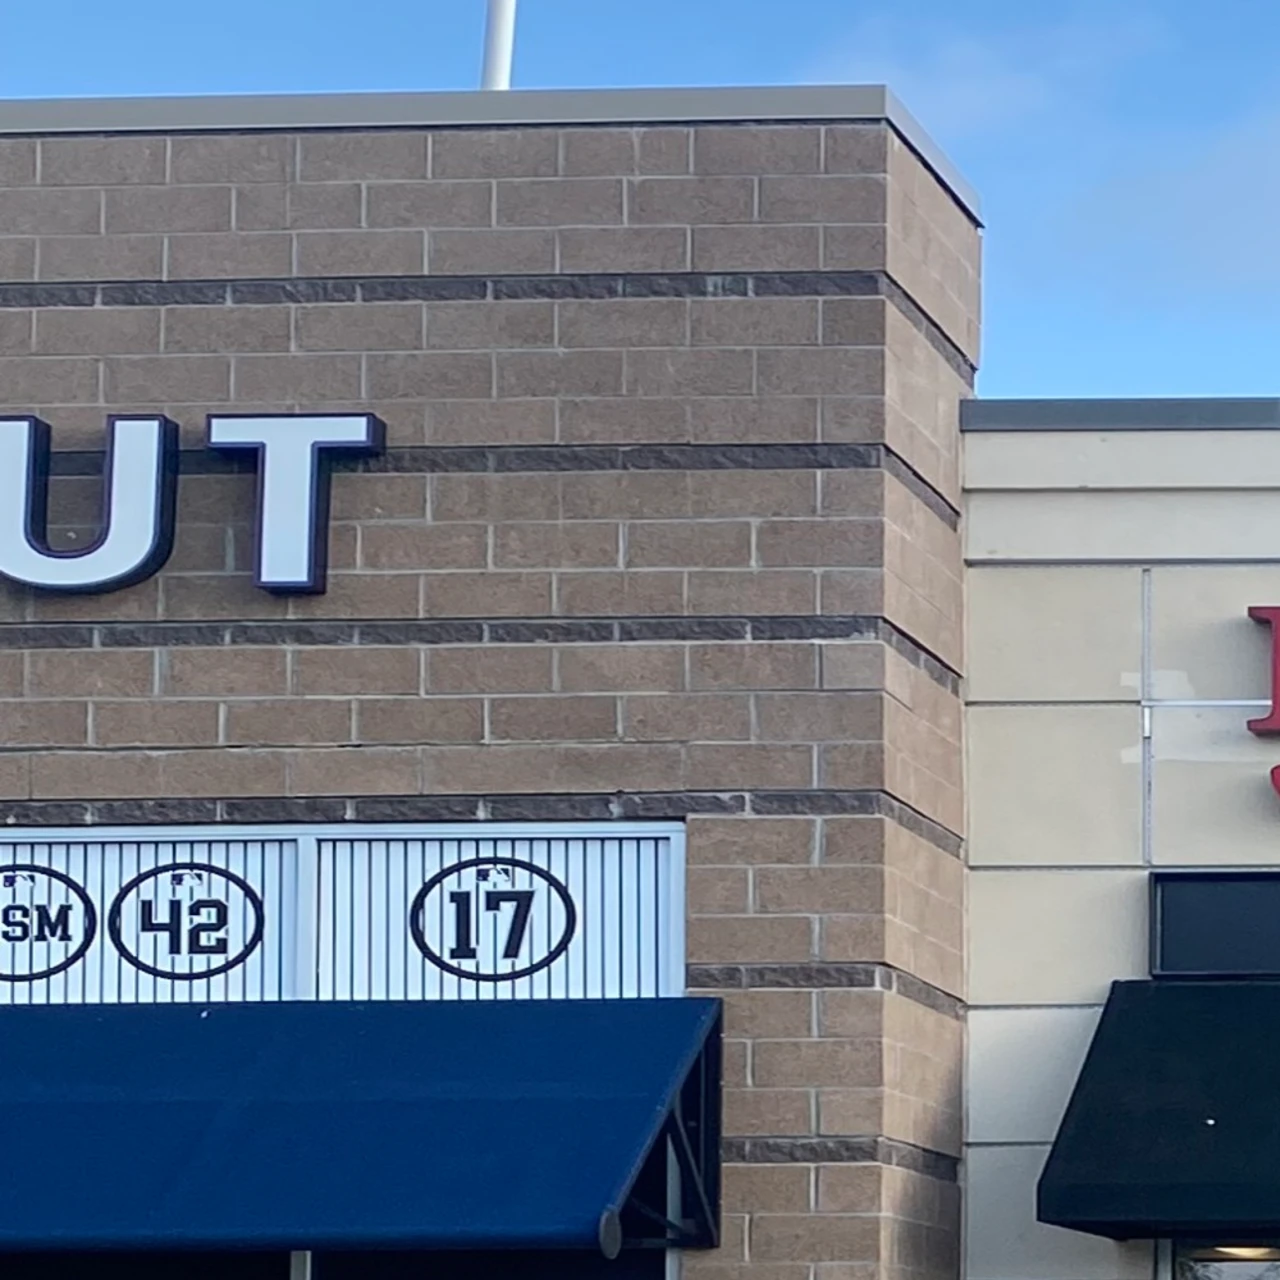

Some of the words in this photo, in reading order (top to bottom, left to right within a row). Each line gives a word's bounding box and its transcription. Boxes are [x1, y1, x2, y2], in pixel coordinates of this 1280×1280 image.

[0, 412, 386, 596] UT
[139, 898, 229, 957] 42
[448, 890, 537, 960] 17
